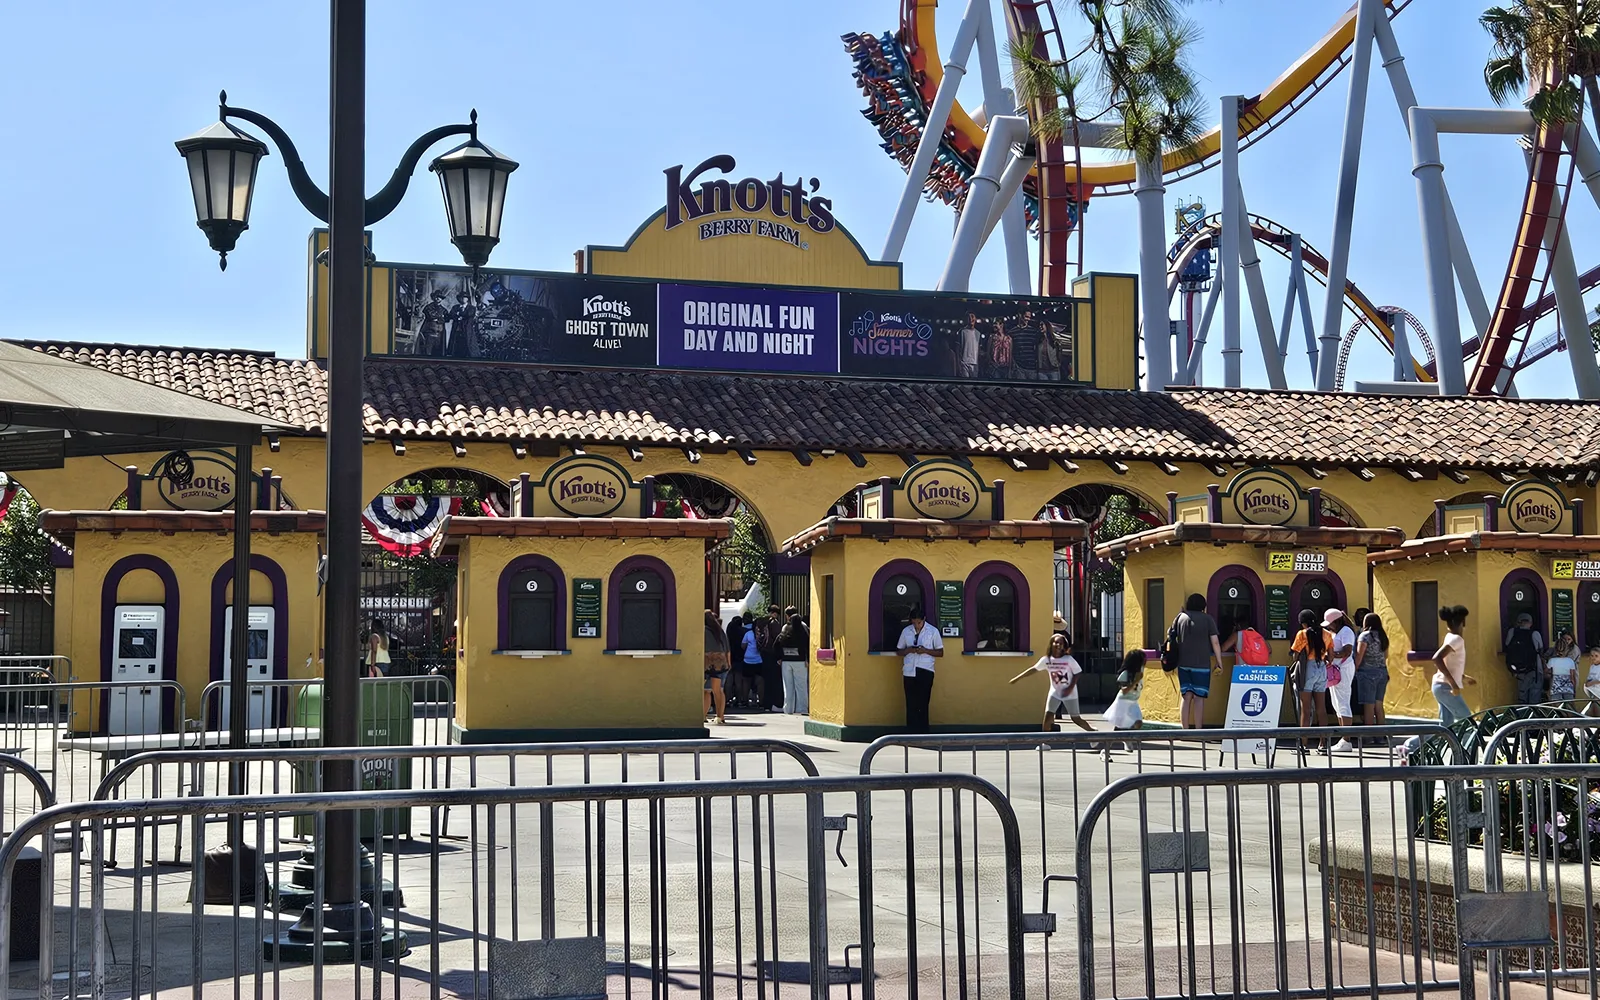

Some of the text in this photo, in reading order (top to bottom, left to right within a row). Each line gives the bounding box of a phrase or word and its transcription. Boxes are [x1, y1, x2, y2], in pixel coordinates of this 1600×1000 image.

[662, 154, 836, 233] Knott's
[698, 218, 801, 248] BERRY FARM
[582, 294, 632, 317] Knott's
[683, 300, 815, 330] ORIGINAL FUN
[565, 319, 649, 338] GHOST TOWN
[868, 322, 914, 339] Summer
[683, 328, 815, 355] DAY AND NIGHT
[853, 337, 929, 356] NIGHTS
[559, 475, 617, 501] Knott's
[917, 479, 971, 504] Knott's
[1242, 488, 1290, 511] Knott's
[1516, 498, 1557, 521] Knott's
[1294, 562, 1325, 572] HERE
[1295, 553, 1324, 562] SOLD
[1575, 560, 1600, 569] SOLD
[1574, 569, 1600, 577] HERE
[361, 758, 393, 773] nott
